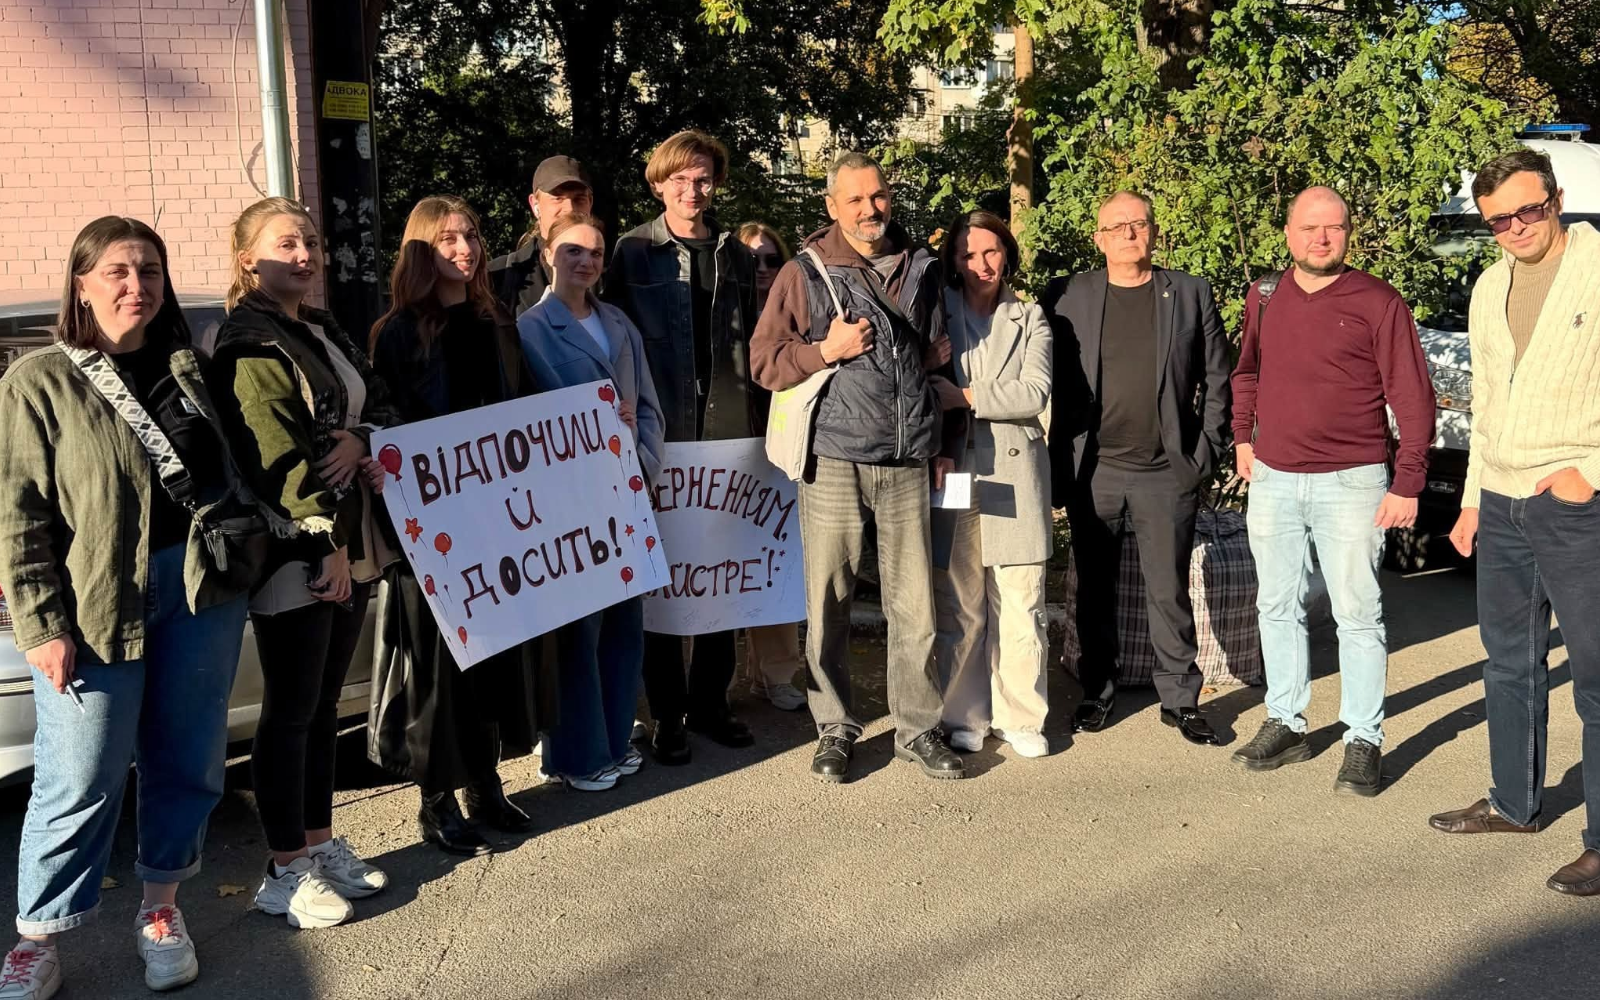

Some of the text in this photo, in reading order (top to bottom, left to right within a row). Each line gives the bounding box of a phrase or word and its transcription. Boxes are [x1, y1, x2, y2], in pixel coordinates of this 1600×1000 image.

[411, 408, 607, 506] ВІДПОЧИЛИ
[504, 486, 542, 531] Й
[460, 516, 623, 619] ДОСИТЬ!
[647, 549, 776, 599] ЙСТРЕ!
